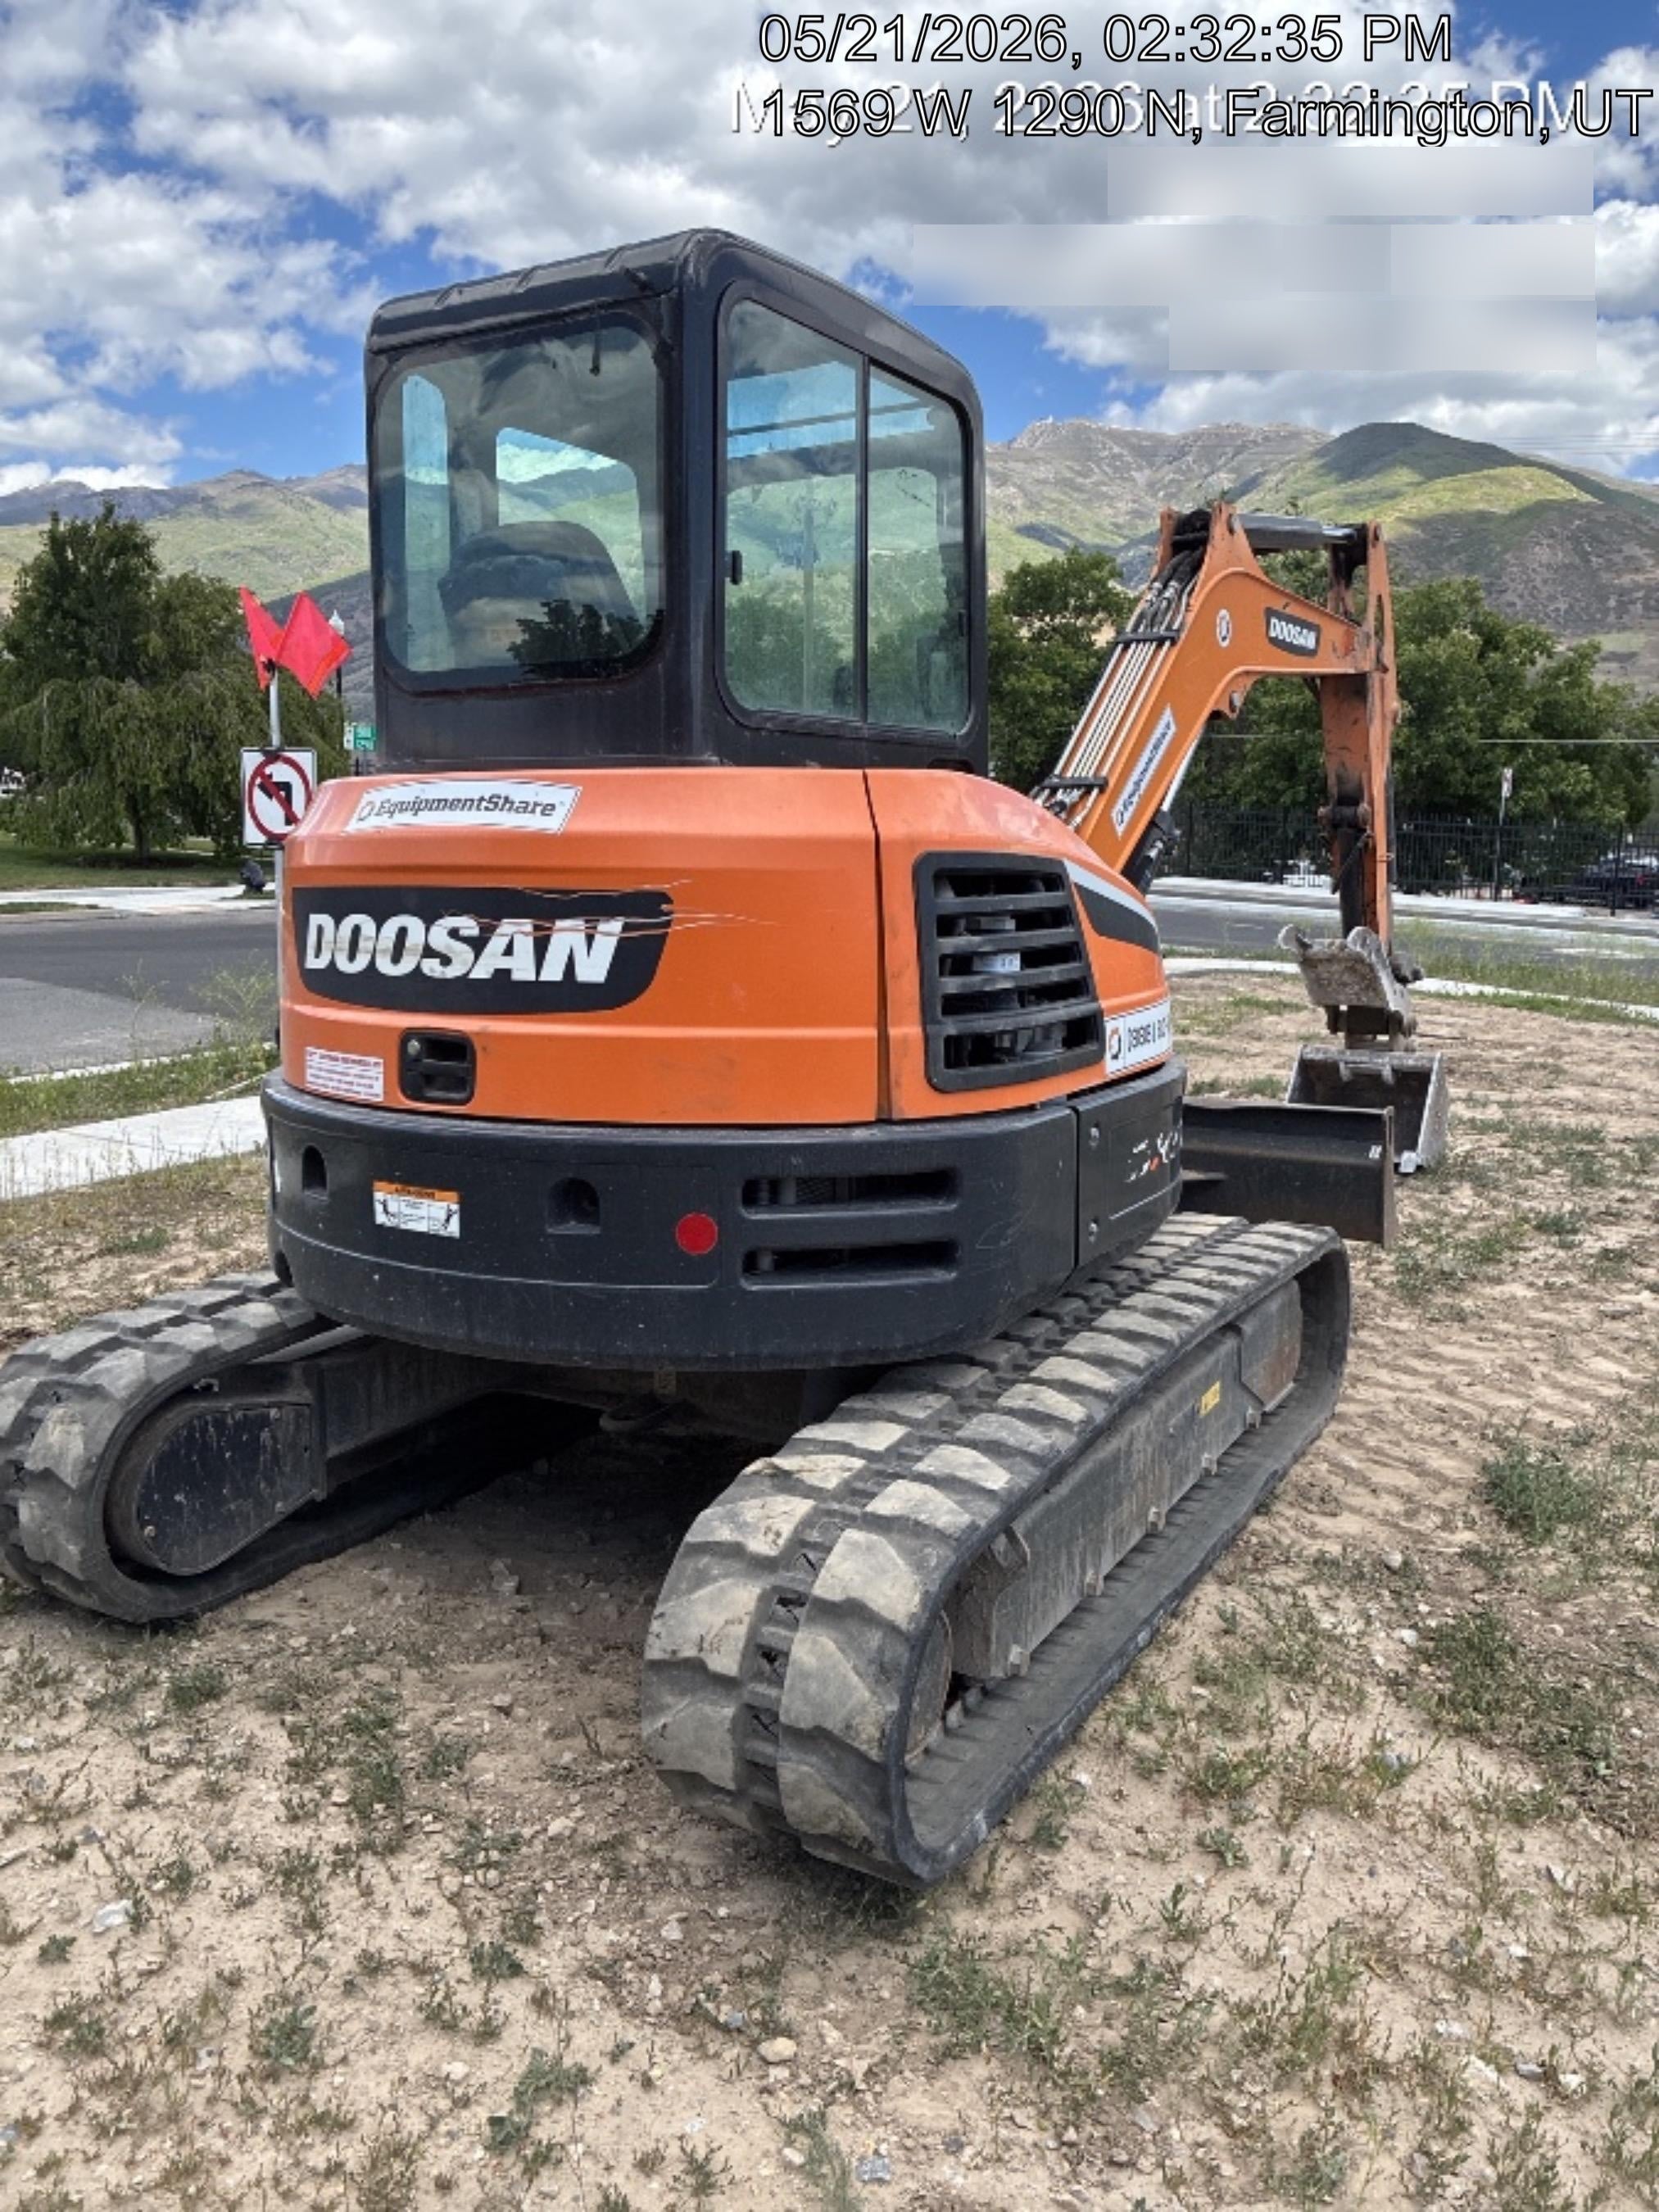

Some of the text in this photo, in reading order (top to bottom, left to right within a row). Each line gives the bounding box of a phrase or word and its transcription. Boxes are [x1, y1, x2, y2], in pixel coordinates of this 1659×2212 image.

[1269, 616, 1317, 650] DOOSAN
[374, 792, 556, 819] EquipmentShare
[305, 913, 624, 983] DOOSAN
